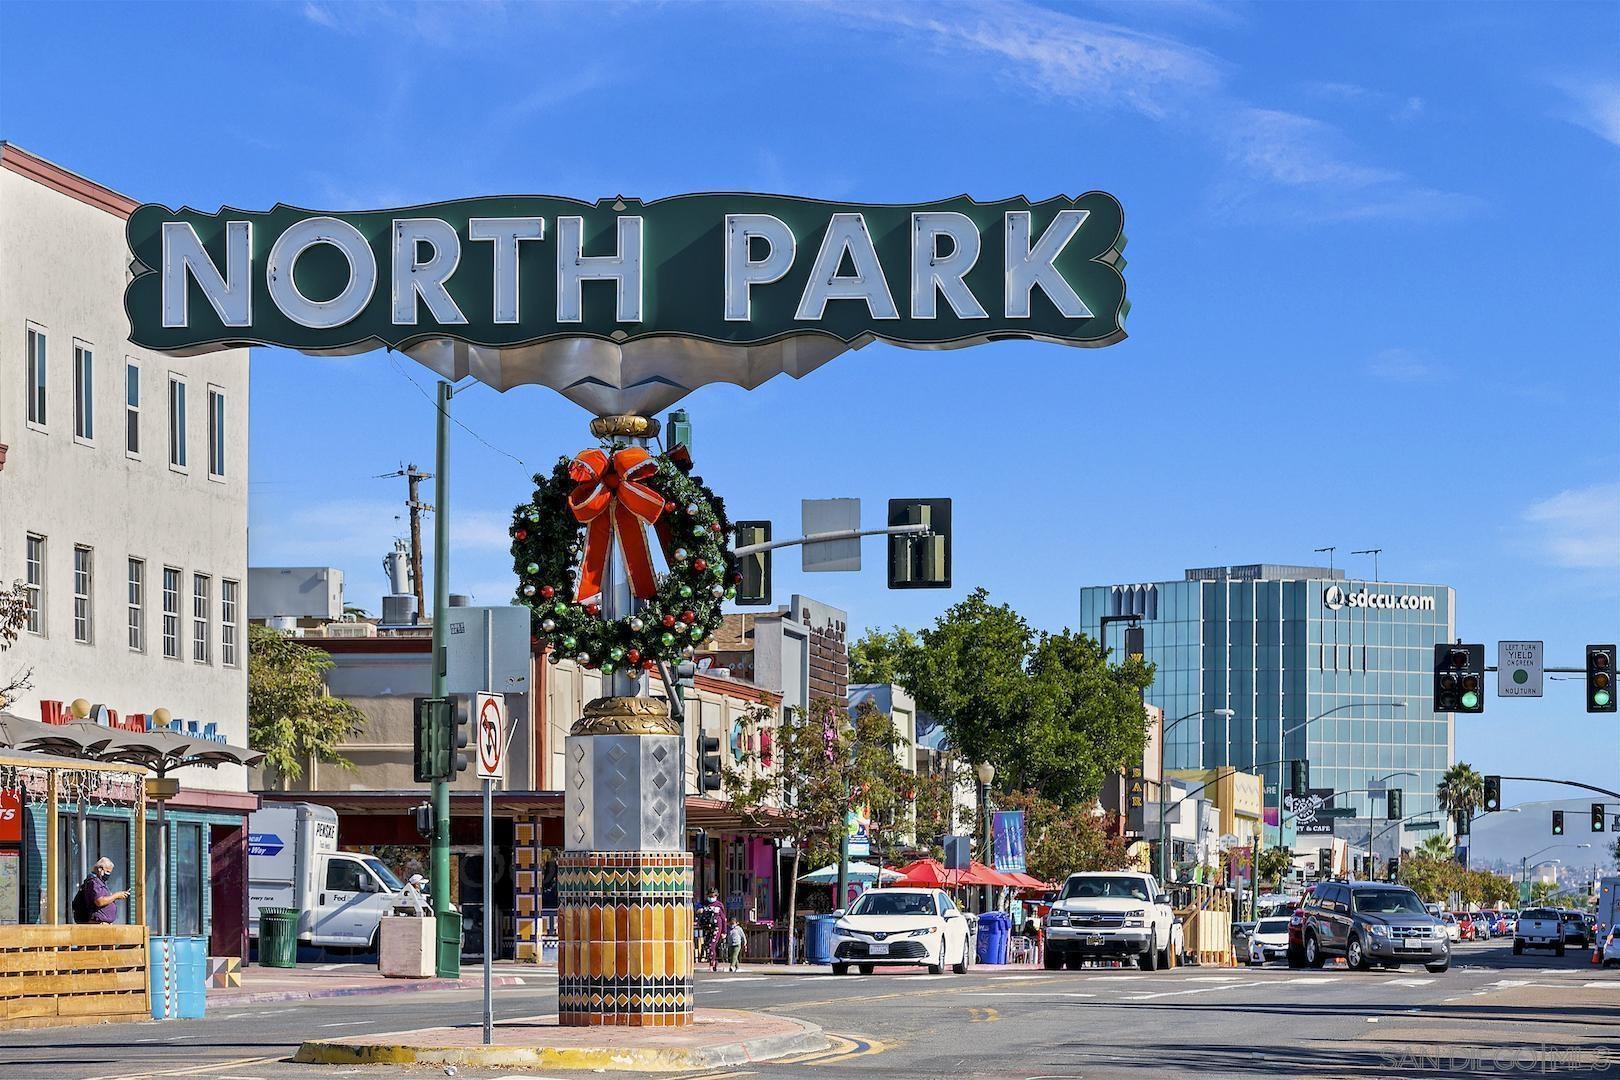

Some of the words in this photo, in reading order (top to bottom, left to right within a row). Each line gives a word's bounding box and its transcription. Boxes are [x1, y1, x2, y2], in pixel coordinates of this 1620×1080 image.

[161, 215, 644, 330] NORTH
[723, 209, 1095, 322] PARK
[1348, 587, 1435, 610] sdccu.com
[1131, 767, 1143, 808] BAR
[316, 823, 335, 839] PENSKE
[251, 846, 267, 856] Way
